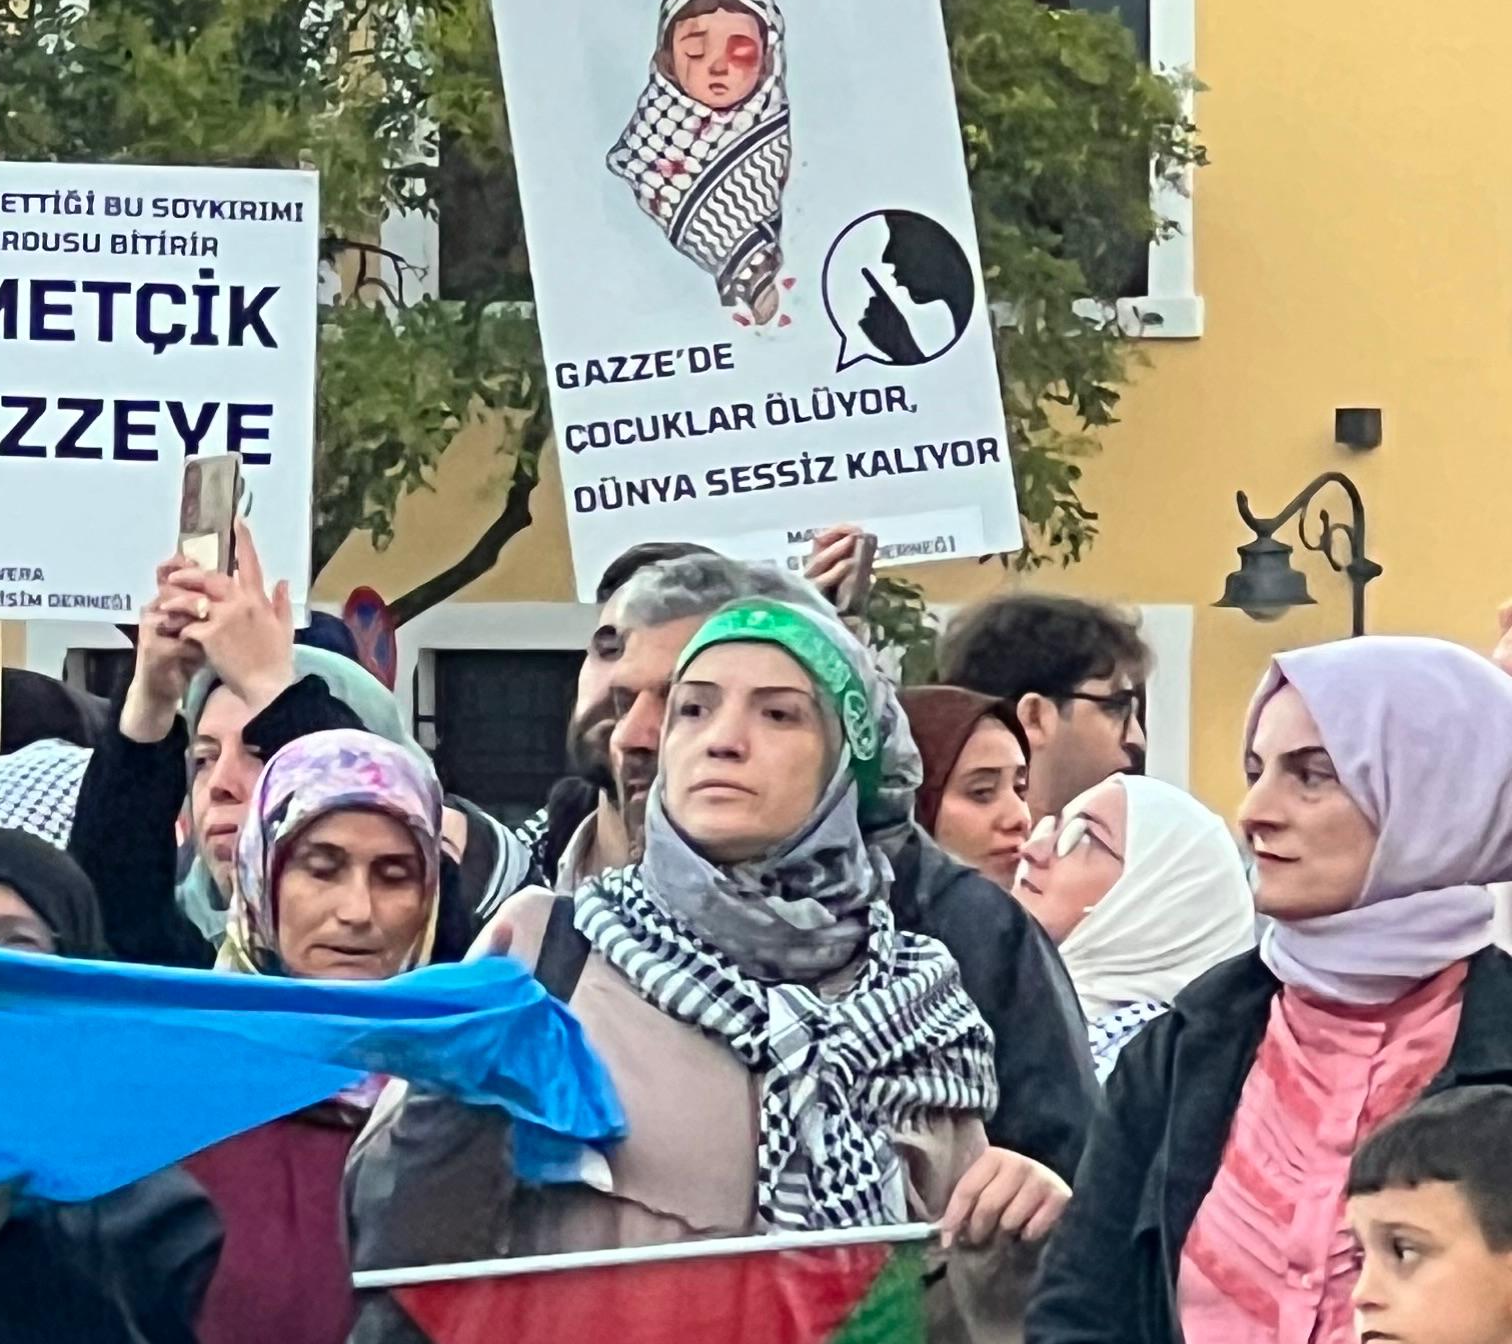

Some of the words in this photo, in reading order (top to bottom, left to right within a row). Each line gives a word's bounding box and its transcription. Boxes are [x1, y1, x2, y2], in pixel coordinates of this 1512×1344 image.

[1, 190, 95, 216] ETTİĞİ
[104, 196, 143, 217] BU
[152, 198, 304, 223] SOYKIRIMI
[111, 229, 219, 257] BİTİRİR
[555, 342, 735, 390] GAZZE'DE
[565, 403, 757, 455] ÇOCUKLAR
[765, 385, 918, 426] ÖLÜYOR,
[574, 474, 697, 514] DÜNYA
[705, 451, 838, 497] SESSİZ
[845, 437, 1001, 480] KALIYOR
